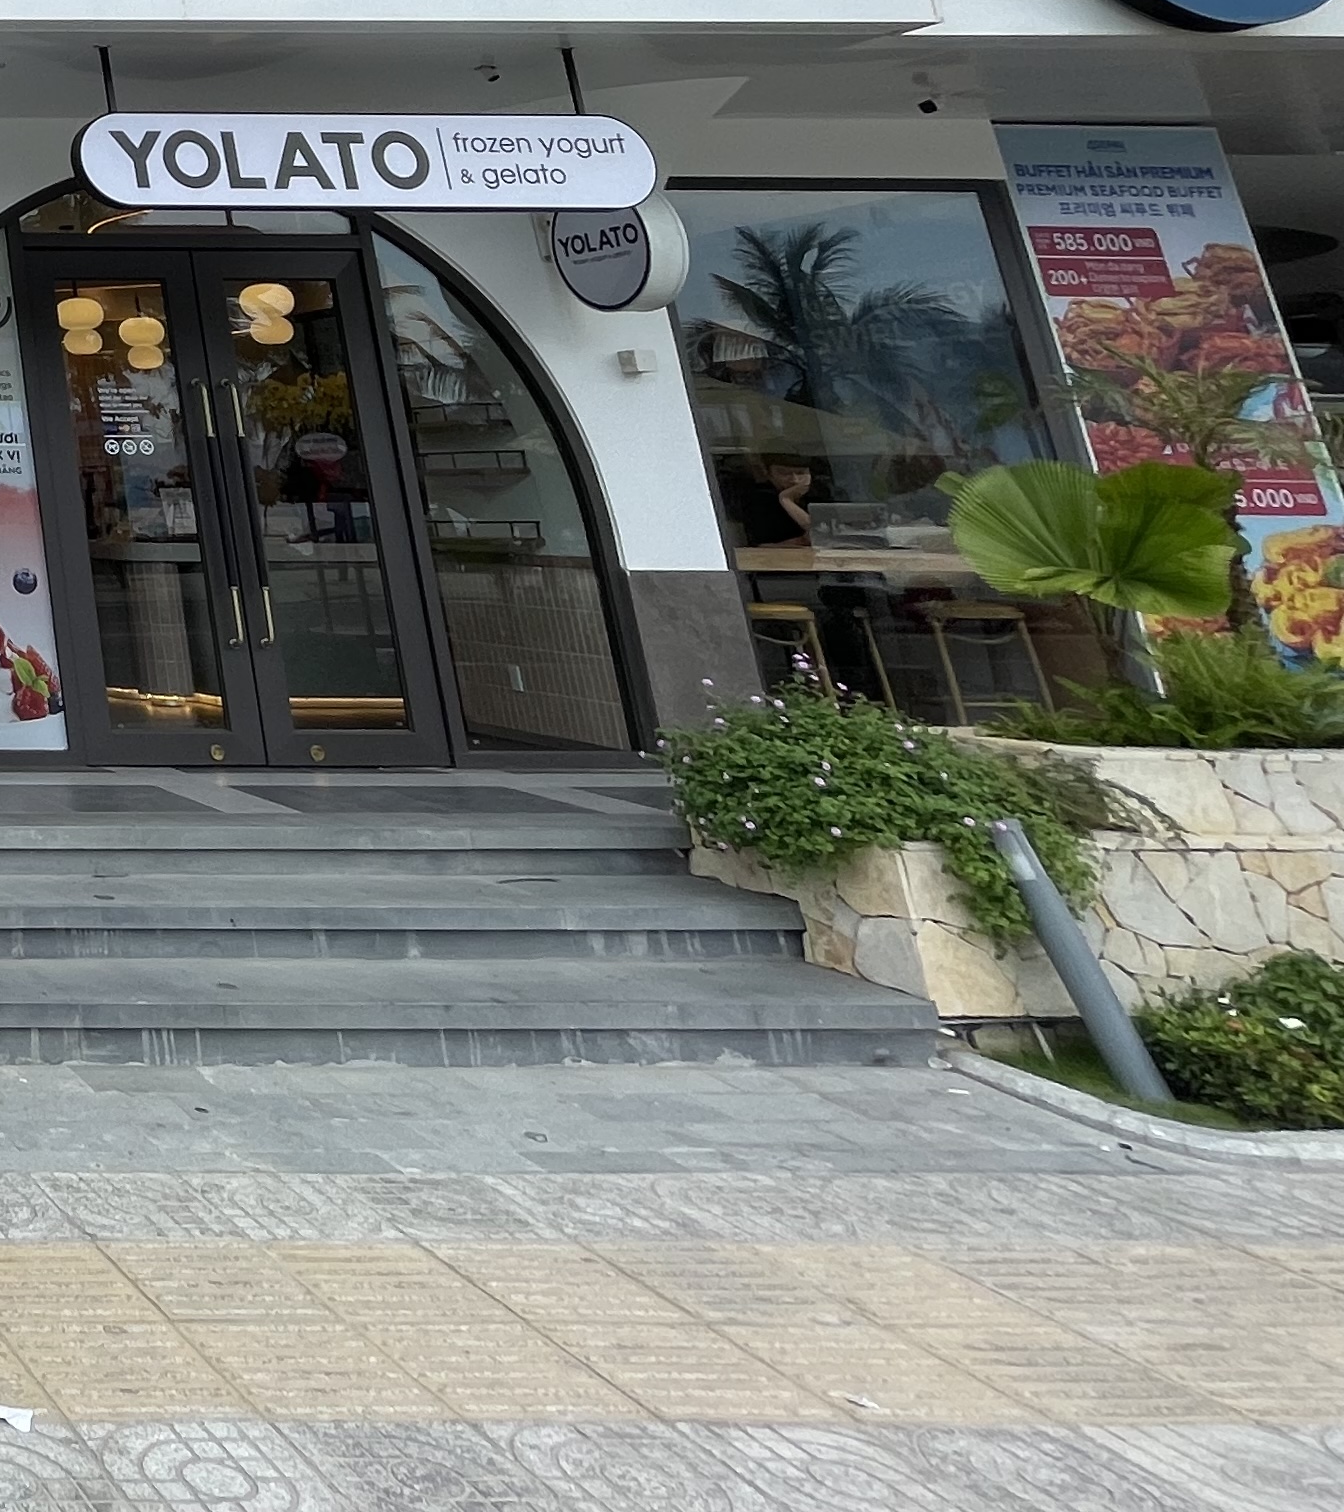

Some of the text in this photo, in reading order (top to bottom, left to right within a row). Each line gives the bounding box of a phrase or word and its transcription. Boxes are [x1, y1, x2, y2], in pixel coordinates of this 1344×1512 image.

[452, 132, 627, 159] frozen yogurt
[109, 130, 429, 191] YOLATO
[461, 163, 568, 189] & gelato
[1014, 164, 1072, 178] BUFFET
[1139, 166, 1215, 180] PREMIUM
[1016, 183, 1222, 199] PREMIUM SEAFOOD BUFFET
[557, 223, 638, 257] YOLATO
[1053, 233, 1133, 251] 585.000
[1047, 270, 1088, 285] 200+
